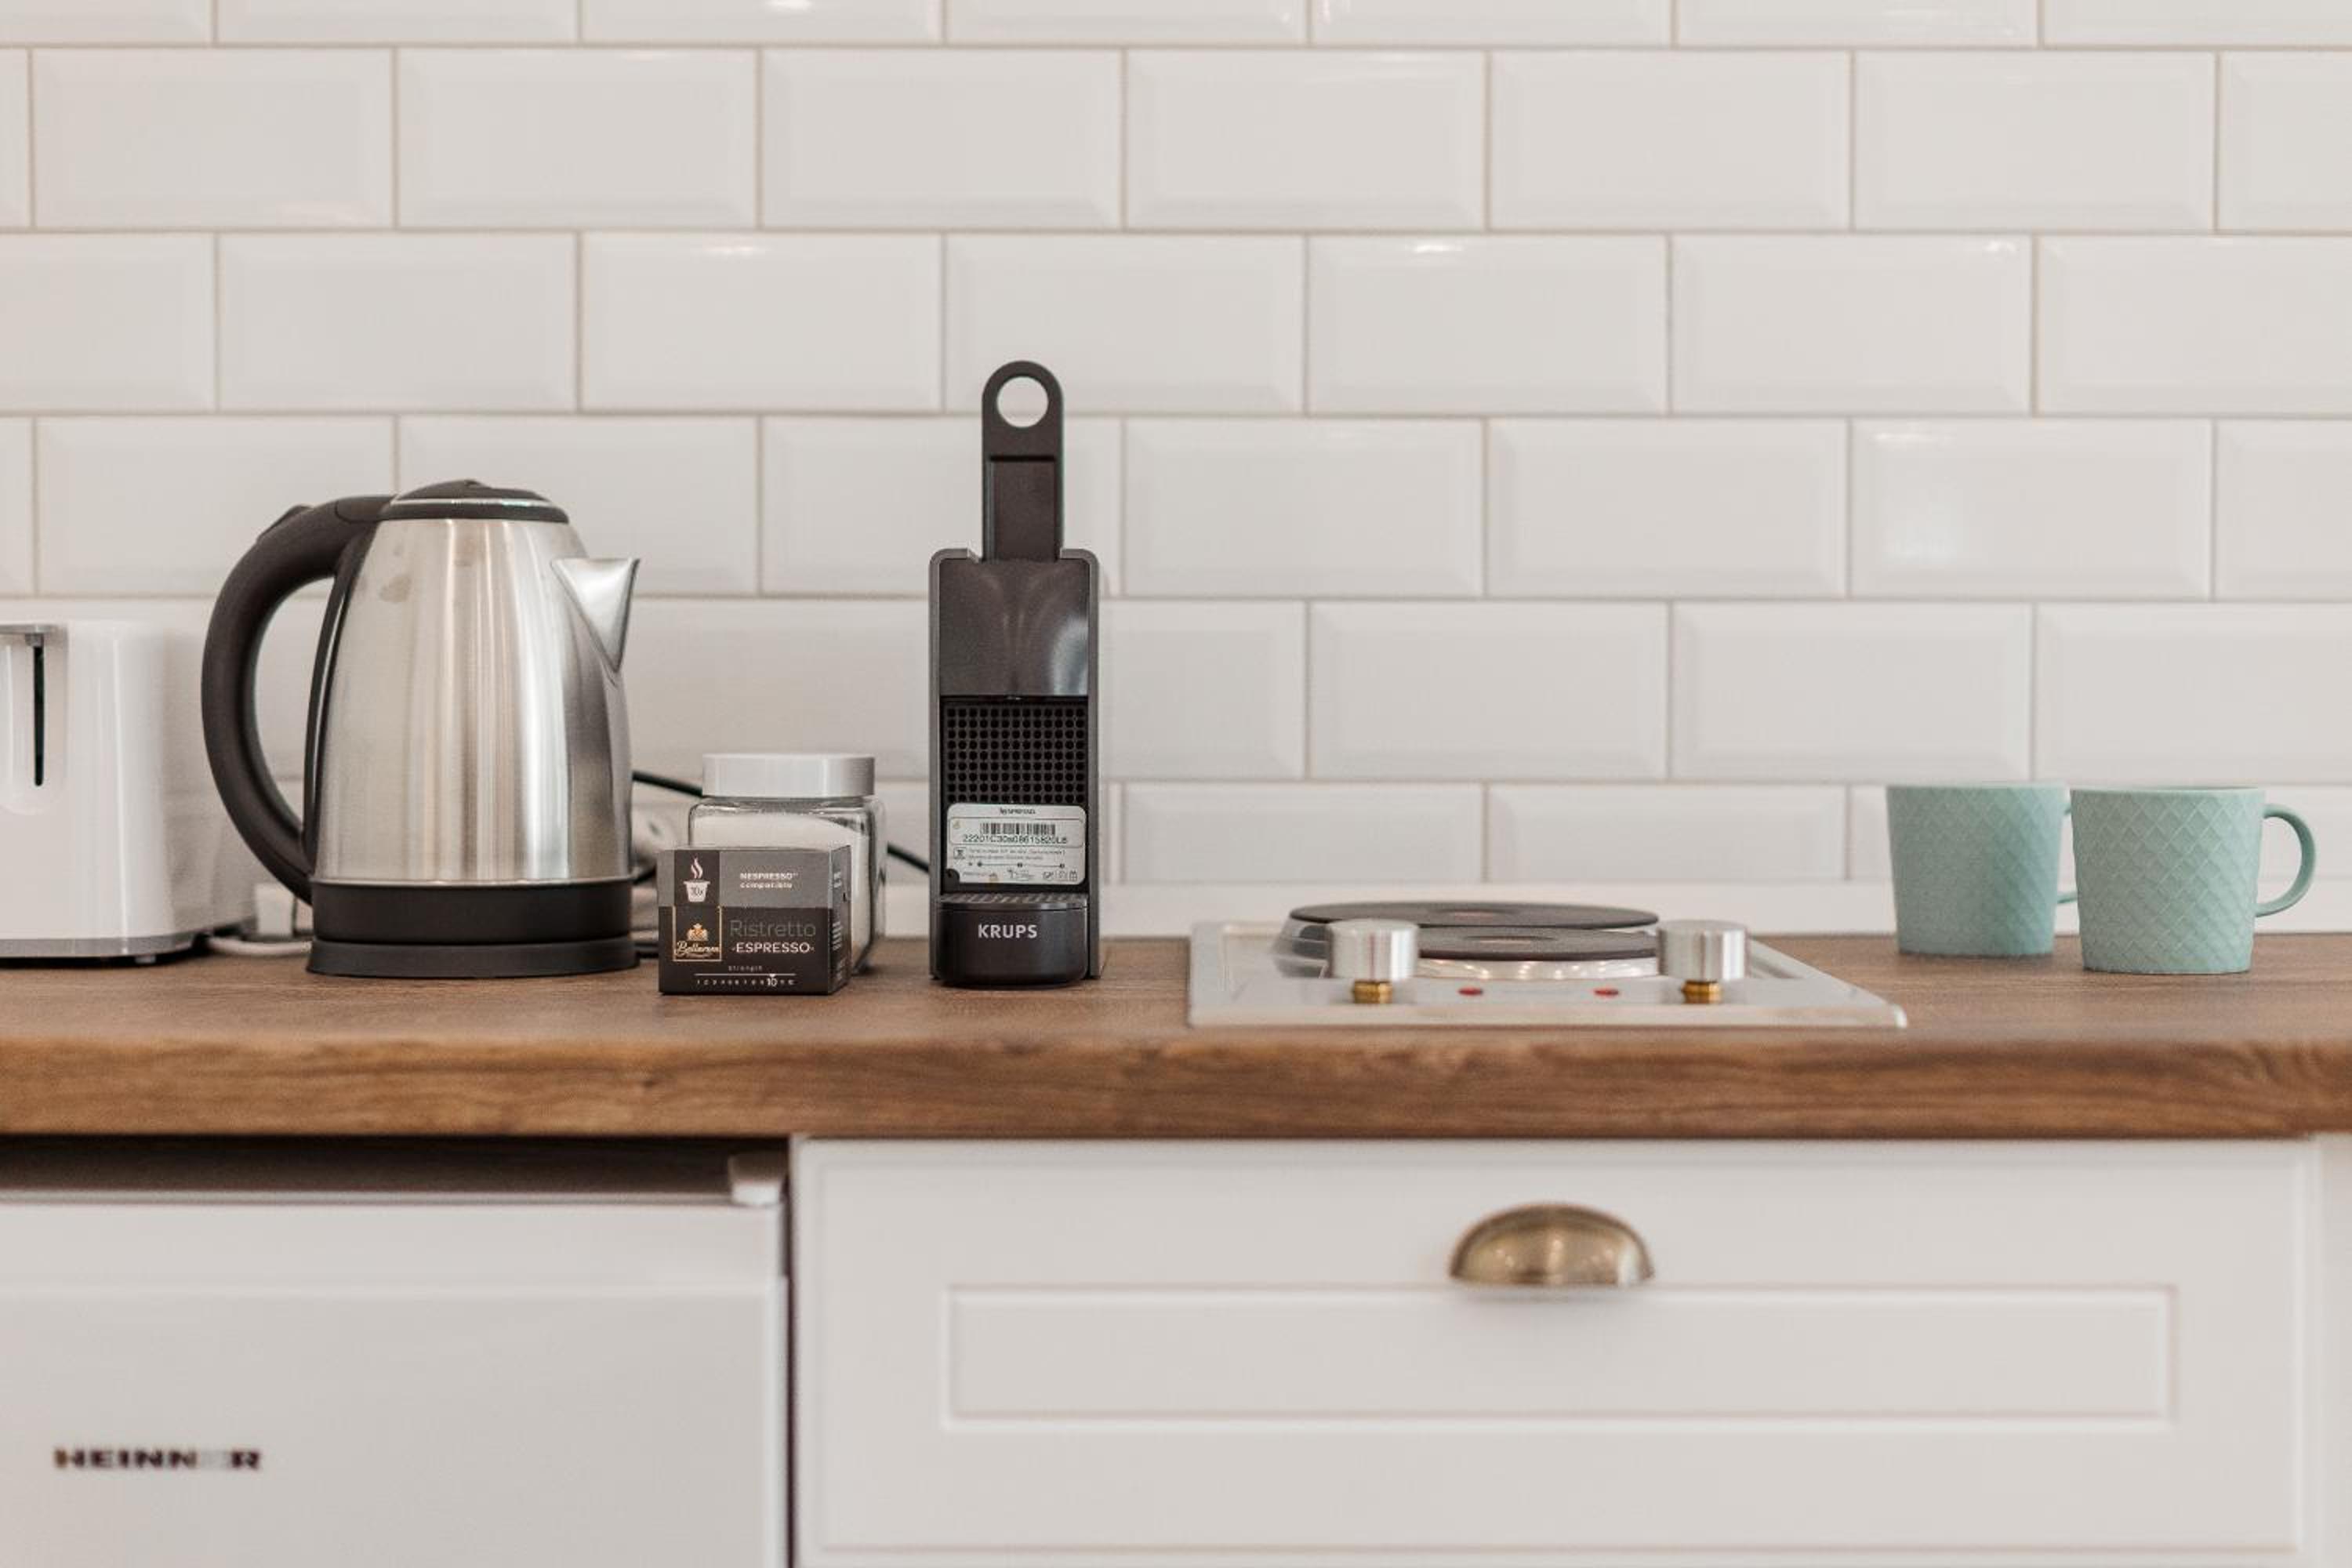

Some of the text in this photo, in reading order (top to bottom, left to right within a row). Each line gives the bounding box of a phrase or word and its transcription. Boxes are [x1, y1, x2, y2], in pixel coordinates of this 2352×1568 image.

[730, 920, 816, 937] Ristretto
[978, 924, 1038, 938] KRUPS
[53, 1448, 261, 1468] HEINNR
